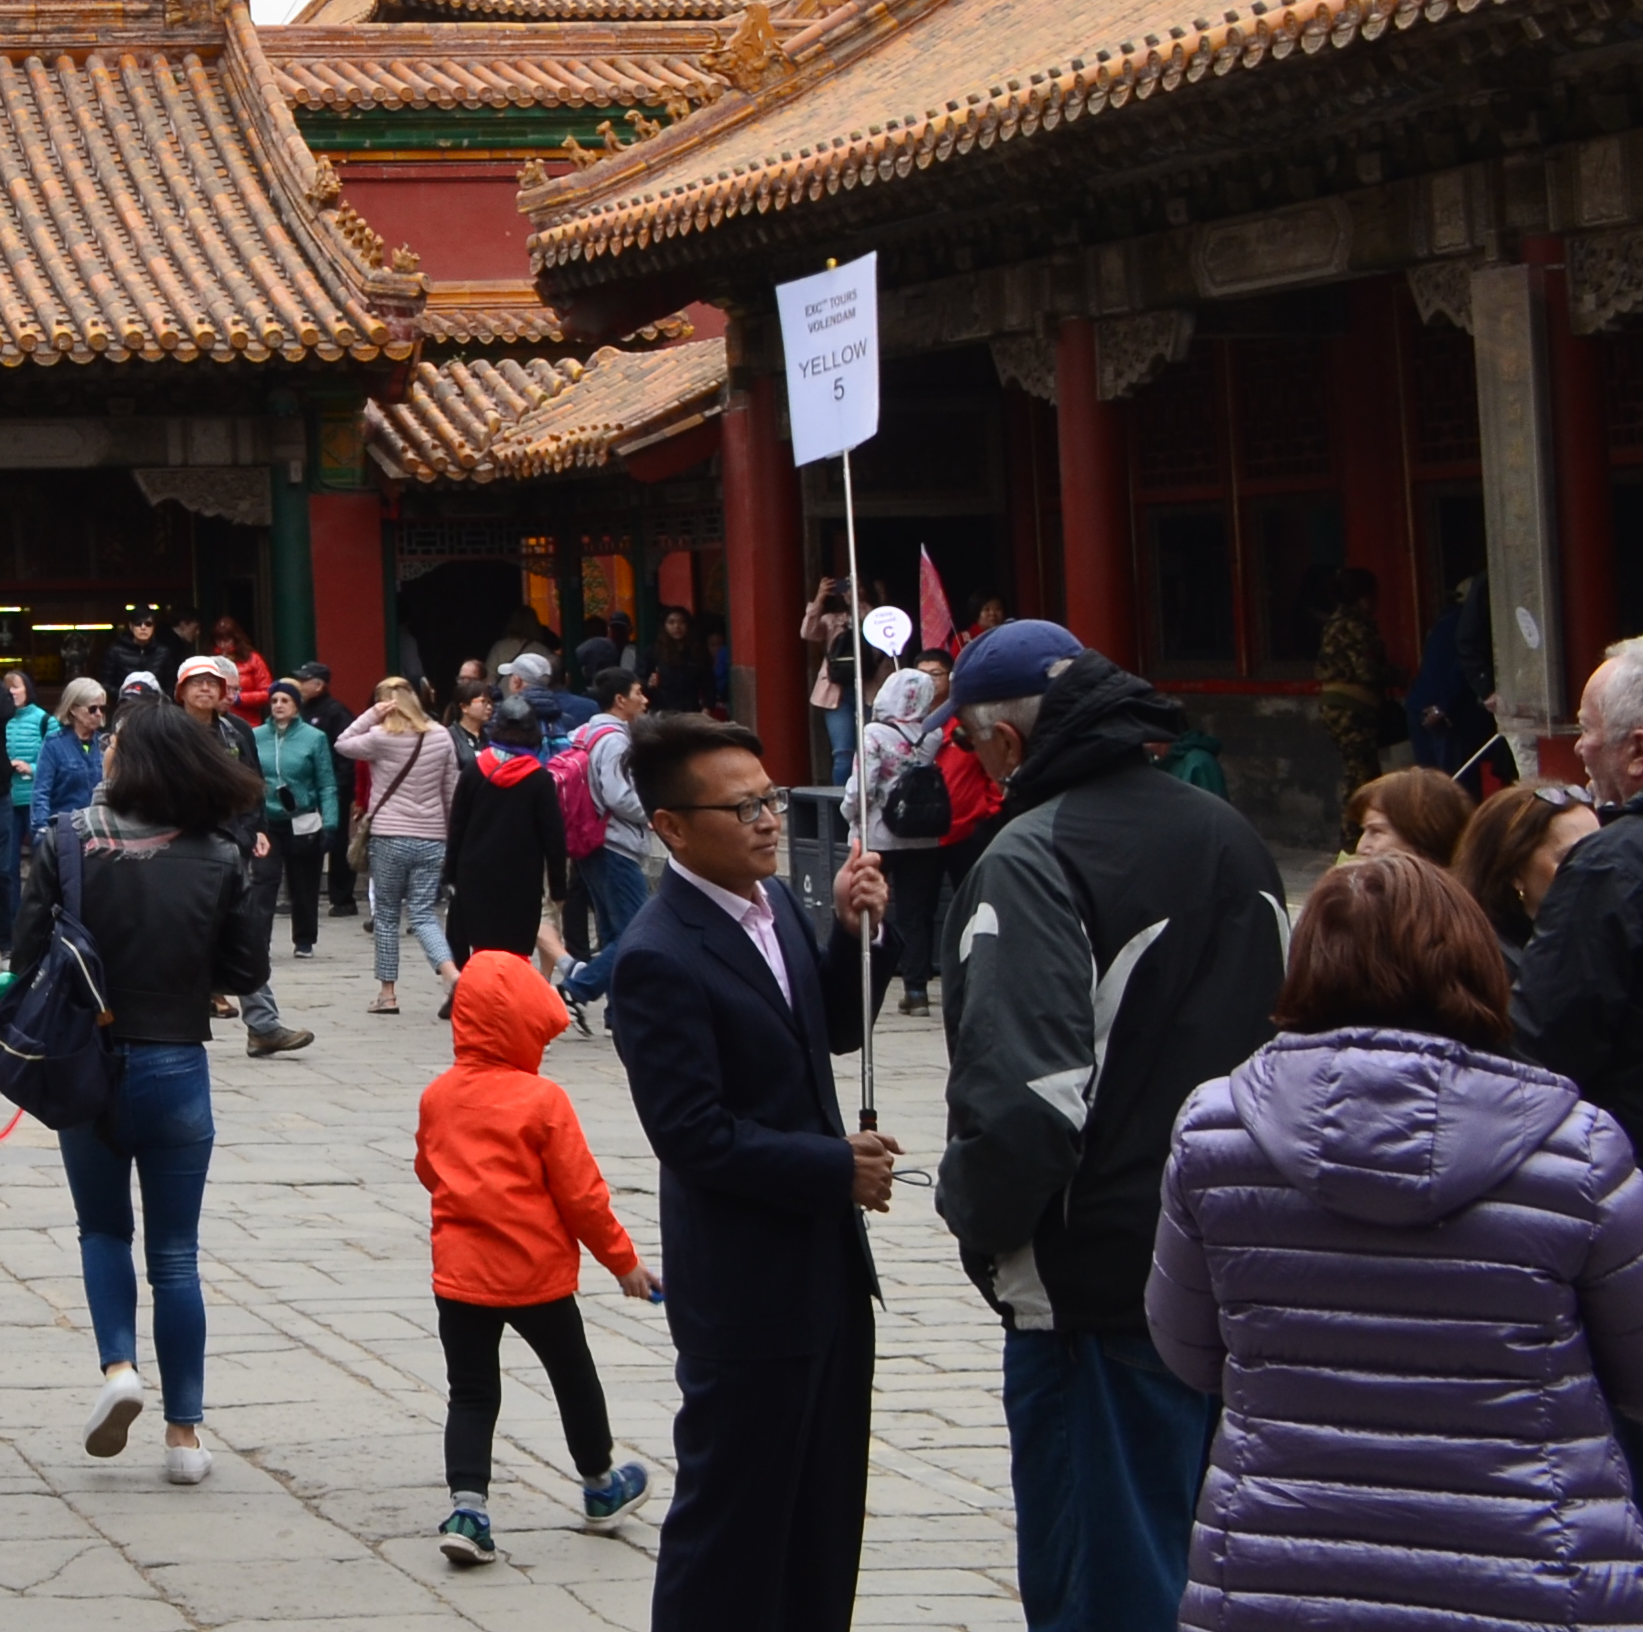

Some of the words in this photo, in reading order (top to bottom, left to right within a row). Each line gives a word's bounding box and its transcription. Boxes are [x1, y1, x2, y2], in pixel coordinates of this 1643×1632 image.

[830, 288, 857, 308] TOURS
[807, 307, 856, 334] VOLENDAM
[798, 337, 867, 379] YELLOW
[833, 376, 845, 401] 5
[882, 625, 895, 638] C
